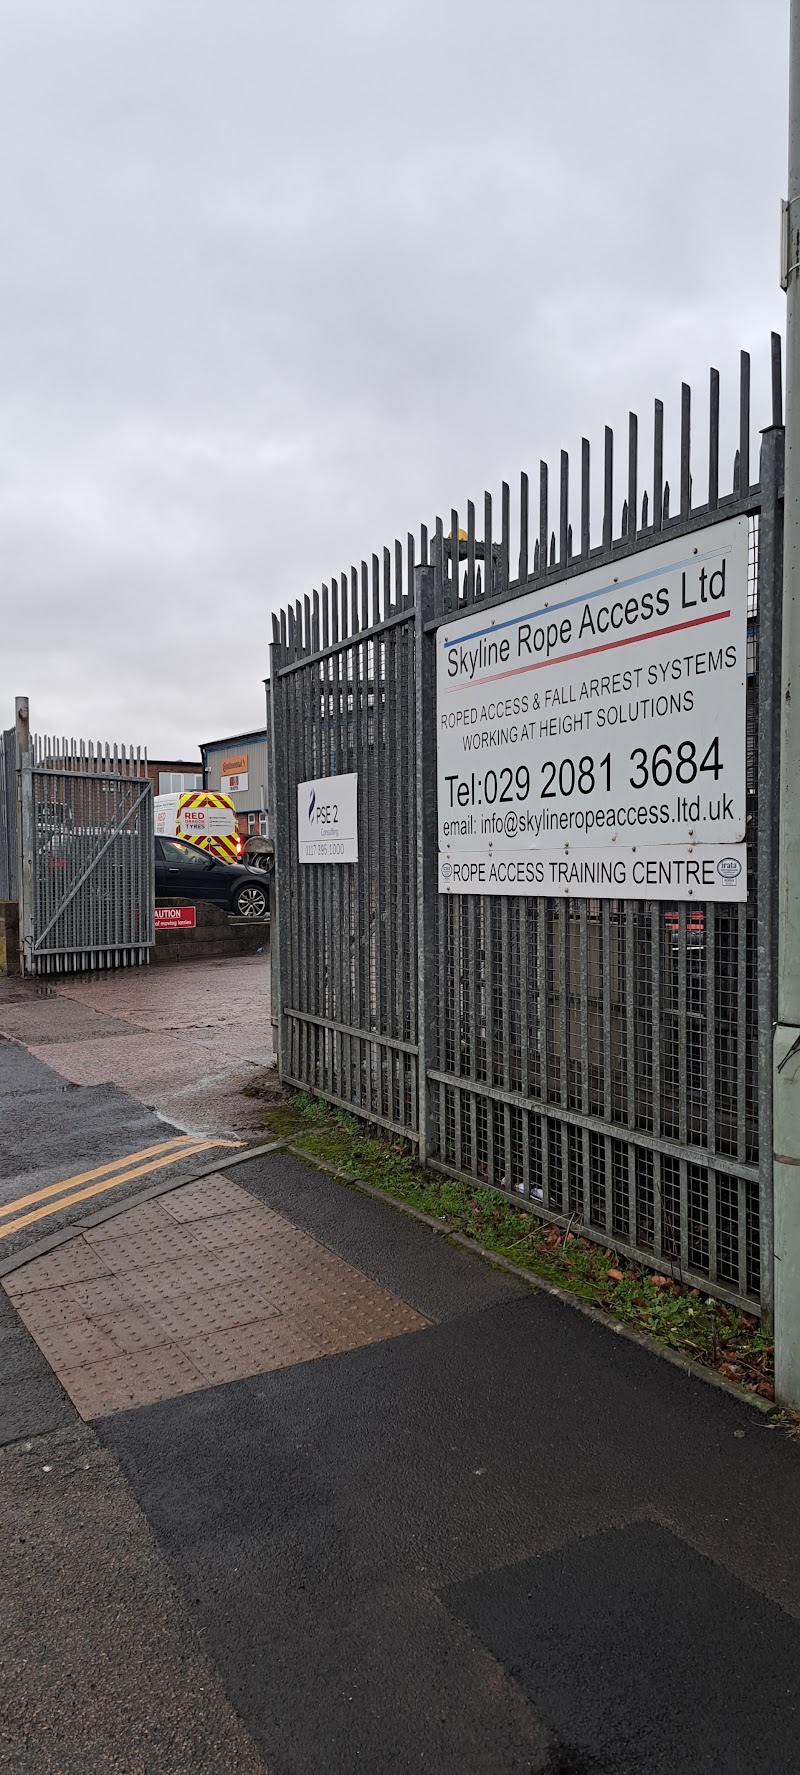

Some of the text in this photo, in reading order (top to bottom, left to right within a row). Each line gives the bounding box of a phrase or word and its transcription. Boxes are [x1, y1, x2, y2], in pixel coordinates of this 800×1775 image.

[447, 558, 727, 679] Skyline Rope Access Ltd
[440, 645, 738, 730] ROPED ACCESS & FALL ARREST SYSTEMS
[462, 690, 695, 751] WORKING AT HEIGHT SOLUTIONS
[540, 752, 612, 799] 2081
[629, 736, 724, 789] 3684
[185, 812, 205, 820] RED
[316, 804, 339, 825] PSE 2
[443, 793, 735, 838] email: info@skylineropeaccess.ltd.uk
[329, 843, 345, 855] 1000
[453, 863, 486, 882] ROPE
[488, 862, 545, 882] ACCESS
[549, 861, 626, 883] TRAINING
[632, 860, 715, 885] CENTRE
[154, 909, 181, 918] AUTION
